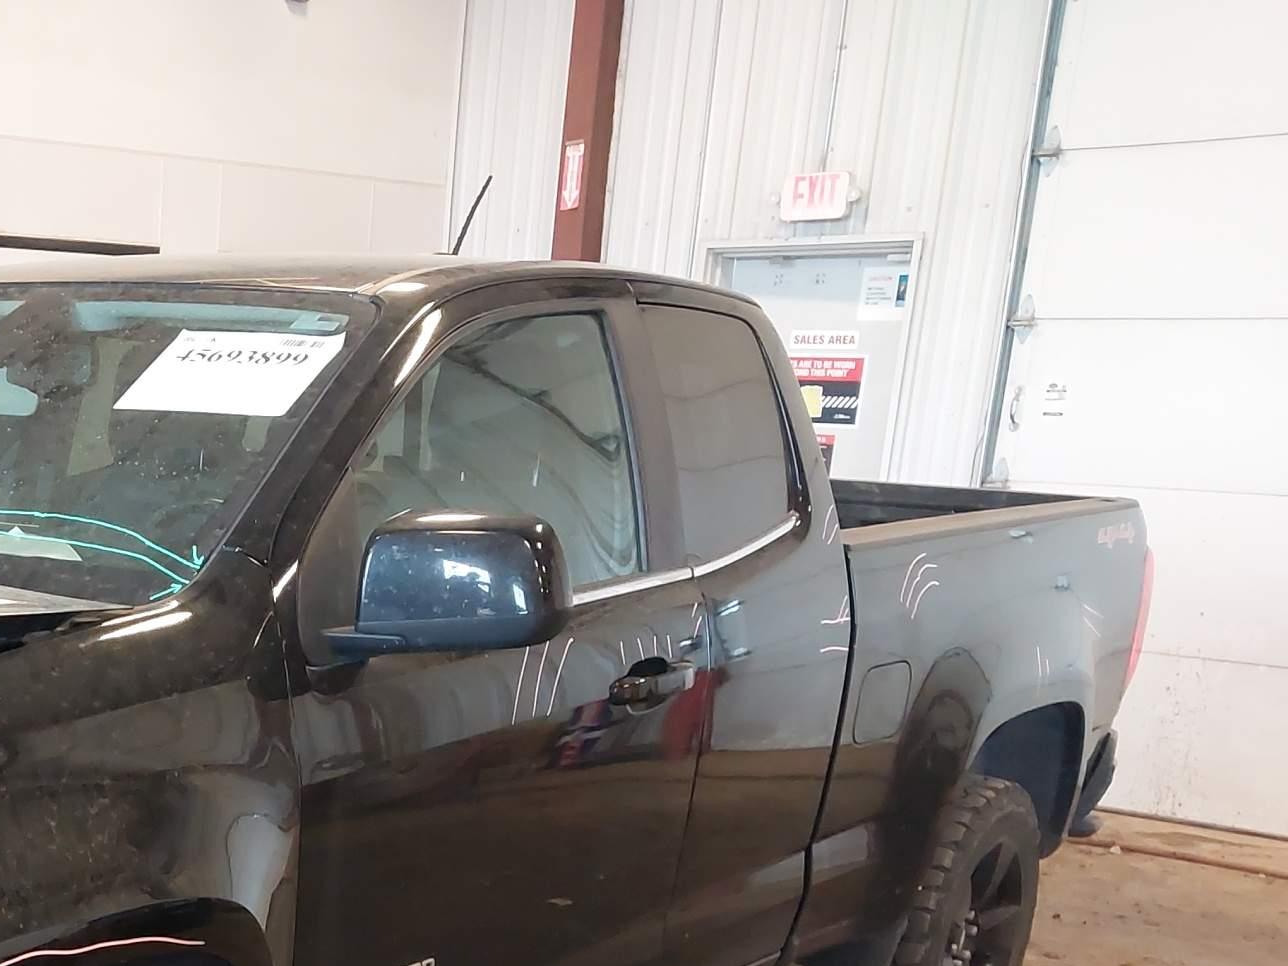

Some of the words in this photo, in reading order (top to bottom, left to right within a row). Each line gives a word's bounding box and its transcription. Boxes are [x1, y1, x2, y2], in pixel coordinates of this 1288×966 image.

[792, 174, 840, 207] EXIT
[793, 335, 825, 345] SALES
[827, 335, 856, 345] AREA
[176, 348, 309, 366] 45693899
[813, 359, 823, 369] TO
